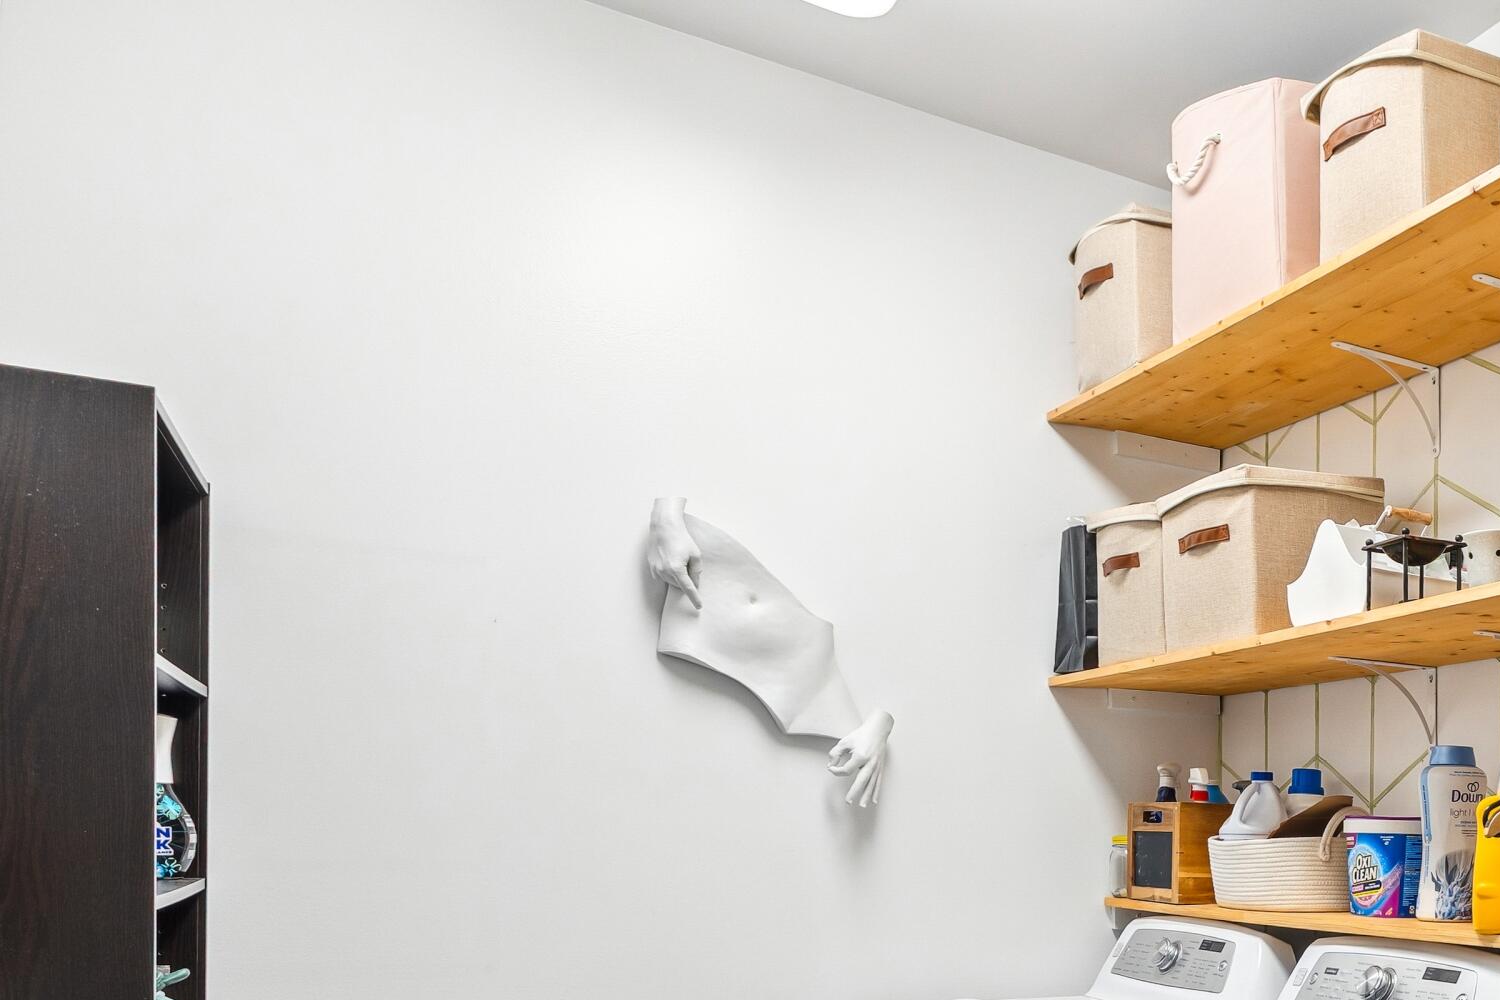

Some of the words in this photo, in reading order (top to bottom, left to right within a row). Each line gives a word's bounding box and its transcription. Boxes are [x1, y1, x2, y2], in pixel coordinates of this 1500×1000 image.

[1451, 789, 1486, 803] Down
[1355, 853, 1372, 869] OXI
[1352, 866, 1377, 884] CLEAN
